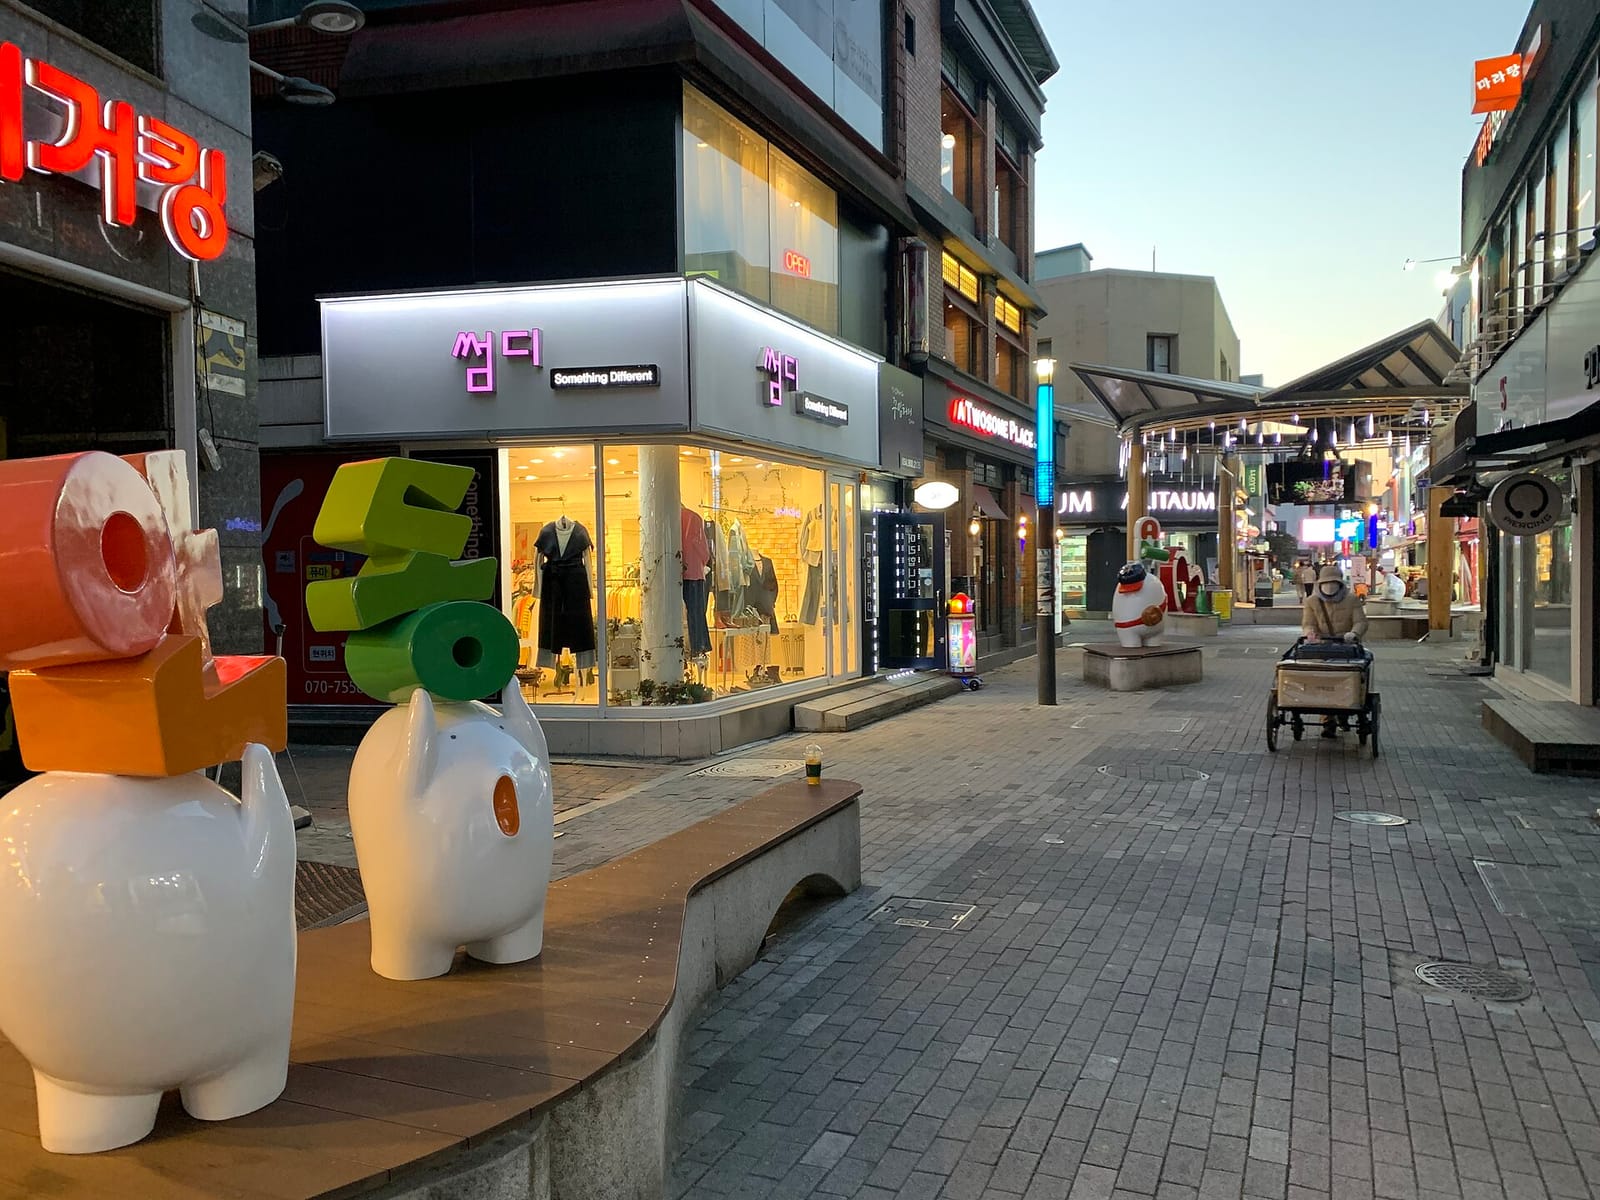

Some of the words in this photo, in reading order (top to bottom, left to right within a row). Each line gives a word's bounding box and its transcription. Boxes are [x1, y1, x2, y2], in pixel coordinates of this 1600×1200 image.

[1476, 63, 1520, 91] 마라탕
[0, 41, 228, 261] 거킹
[785, 252, 809, 276] OPEN
[451, 328, 543, 394] 썸디
[554, 372, 608, 385] Something
[610, 370, 653, 382] Different
[763, 346, 799, 406] 썸디
[1503, 513, 1552, 529] PIERCING
